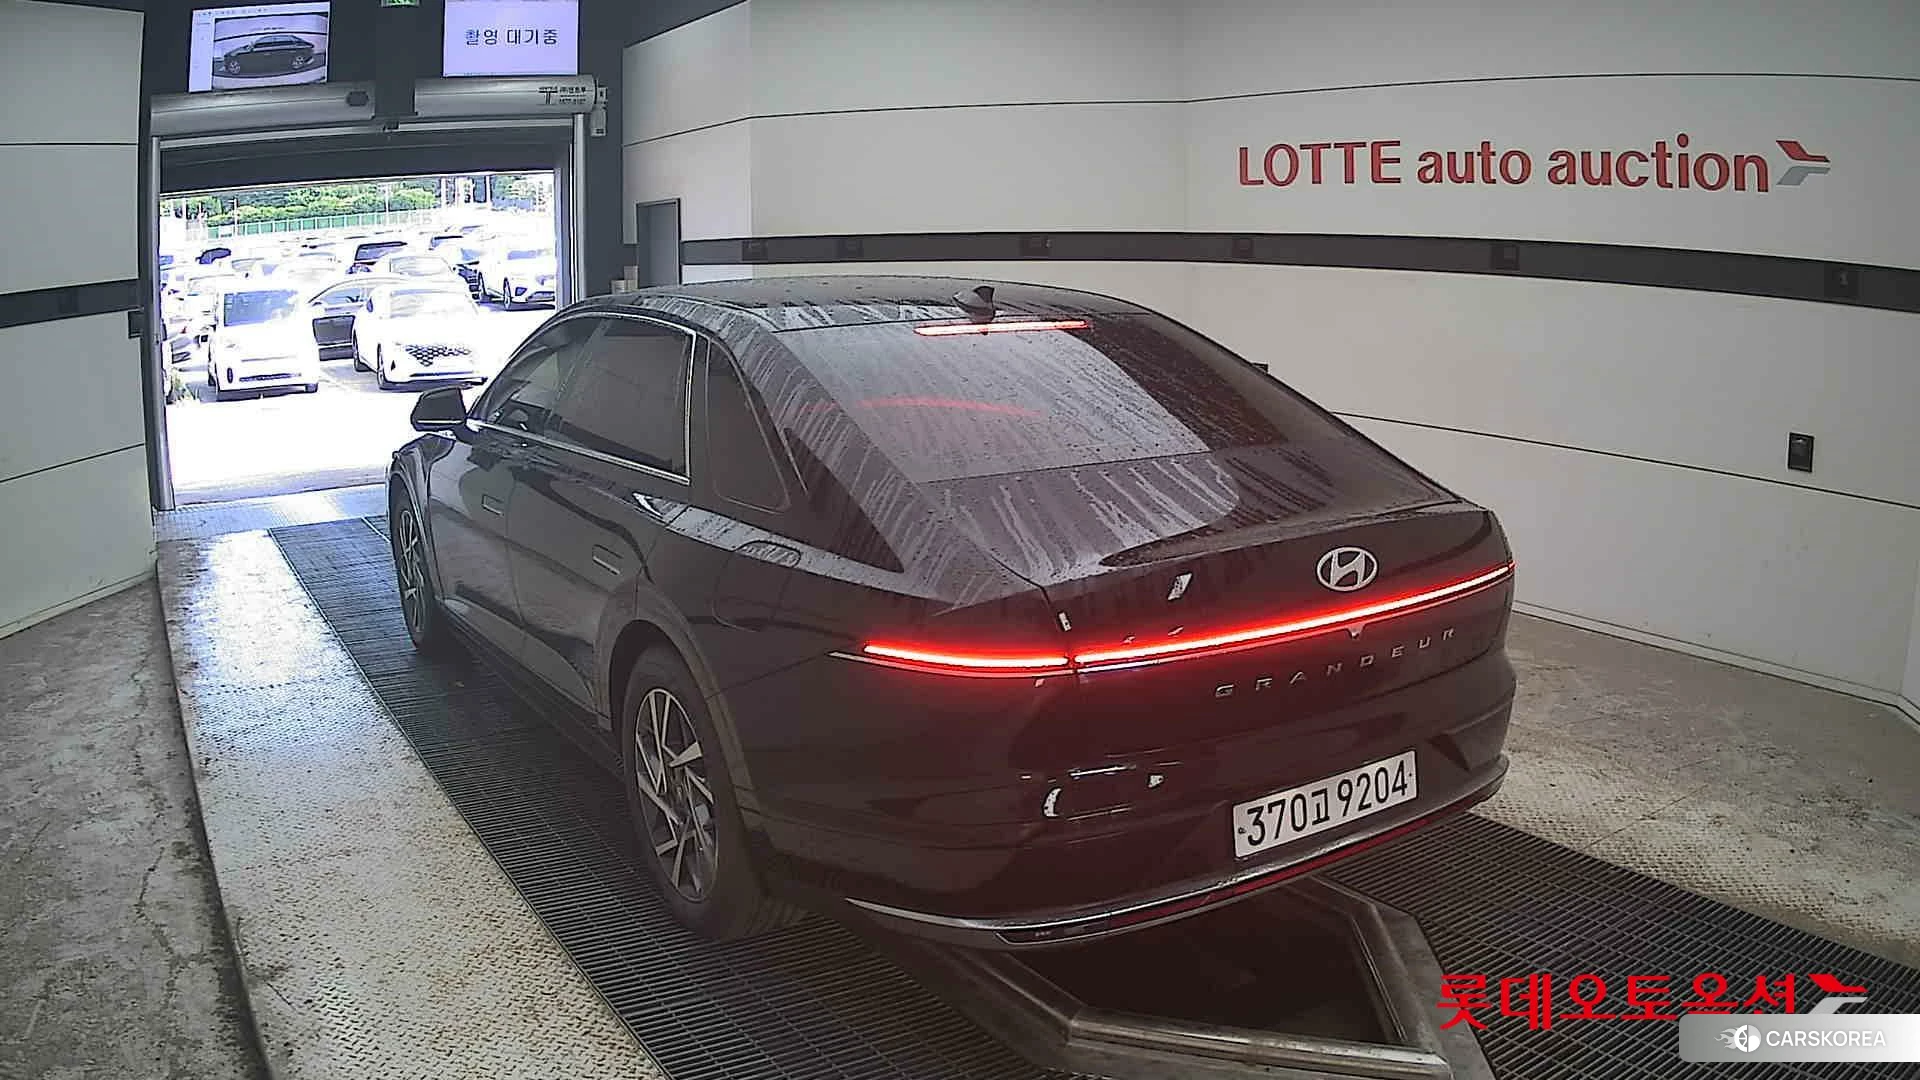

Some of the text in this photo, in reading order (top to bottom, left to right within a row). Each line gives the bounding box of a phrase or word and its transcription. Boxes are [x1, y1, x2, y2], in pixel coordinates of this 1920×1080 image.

[1239, 133, 1770, 192] LOTTE auto auction
[1215, 628, 1455, 698] GRANDEUR
